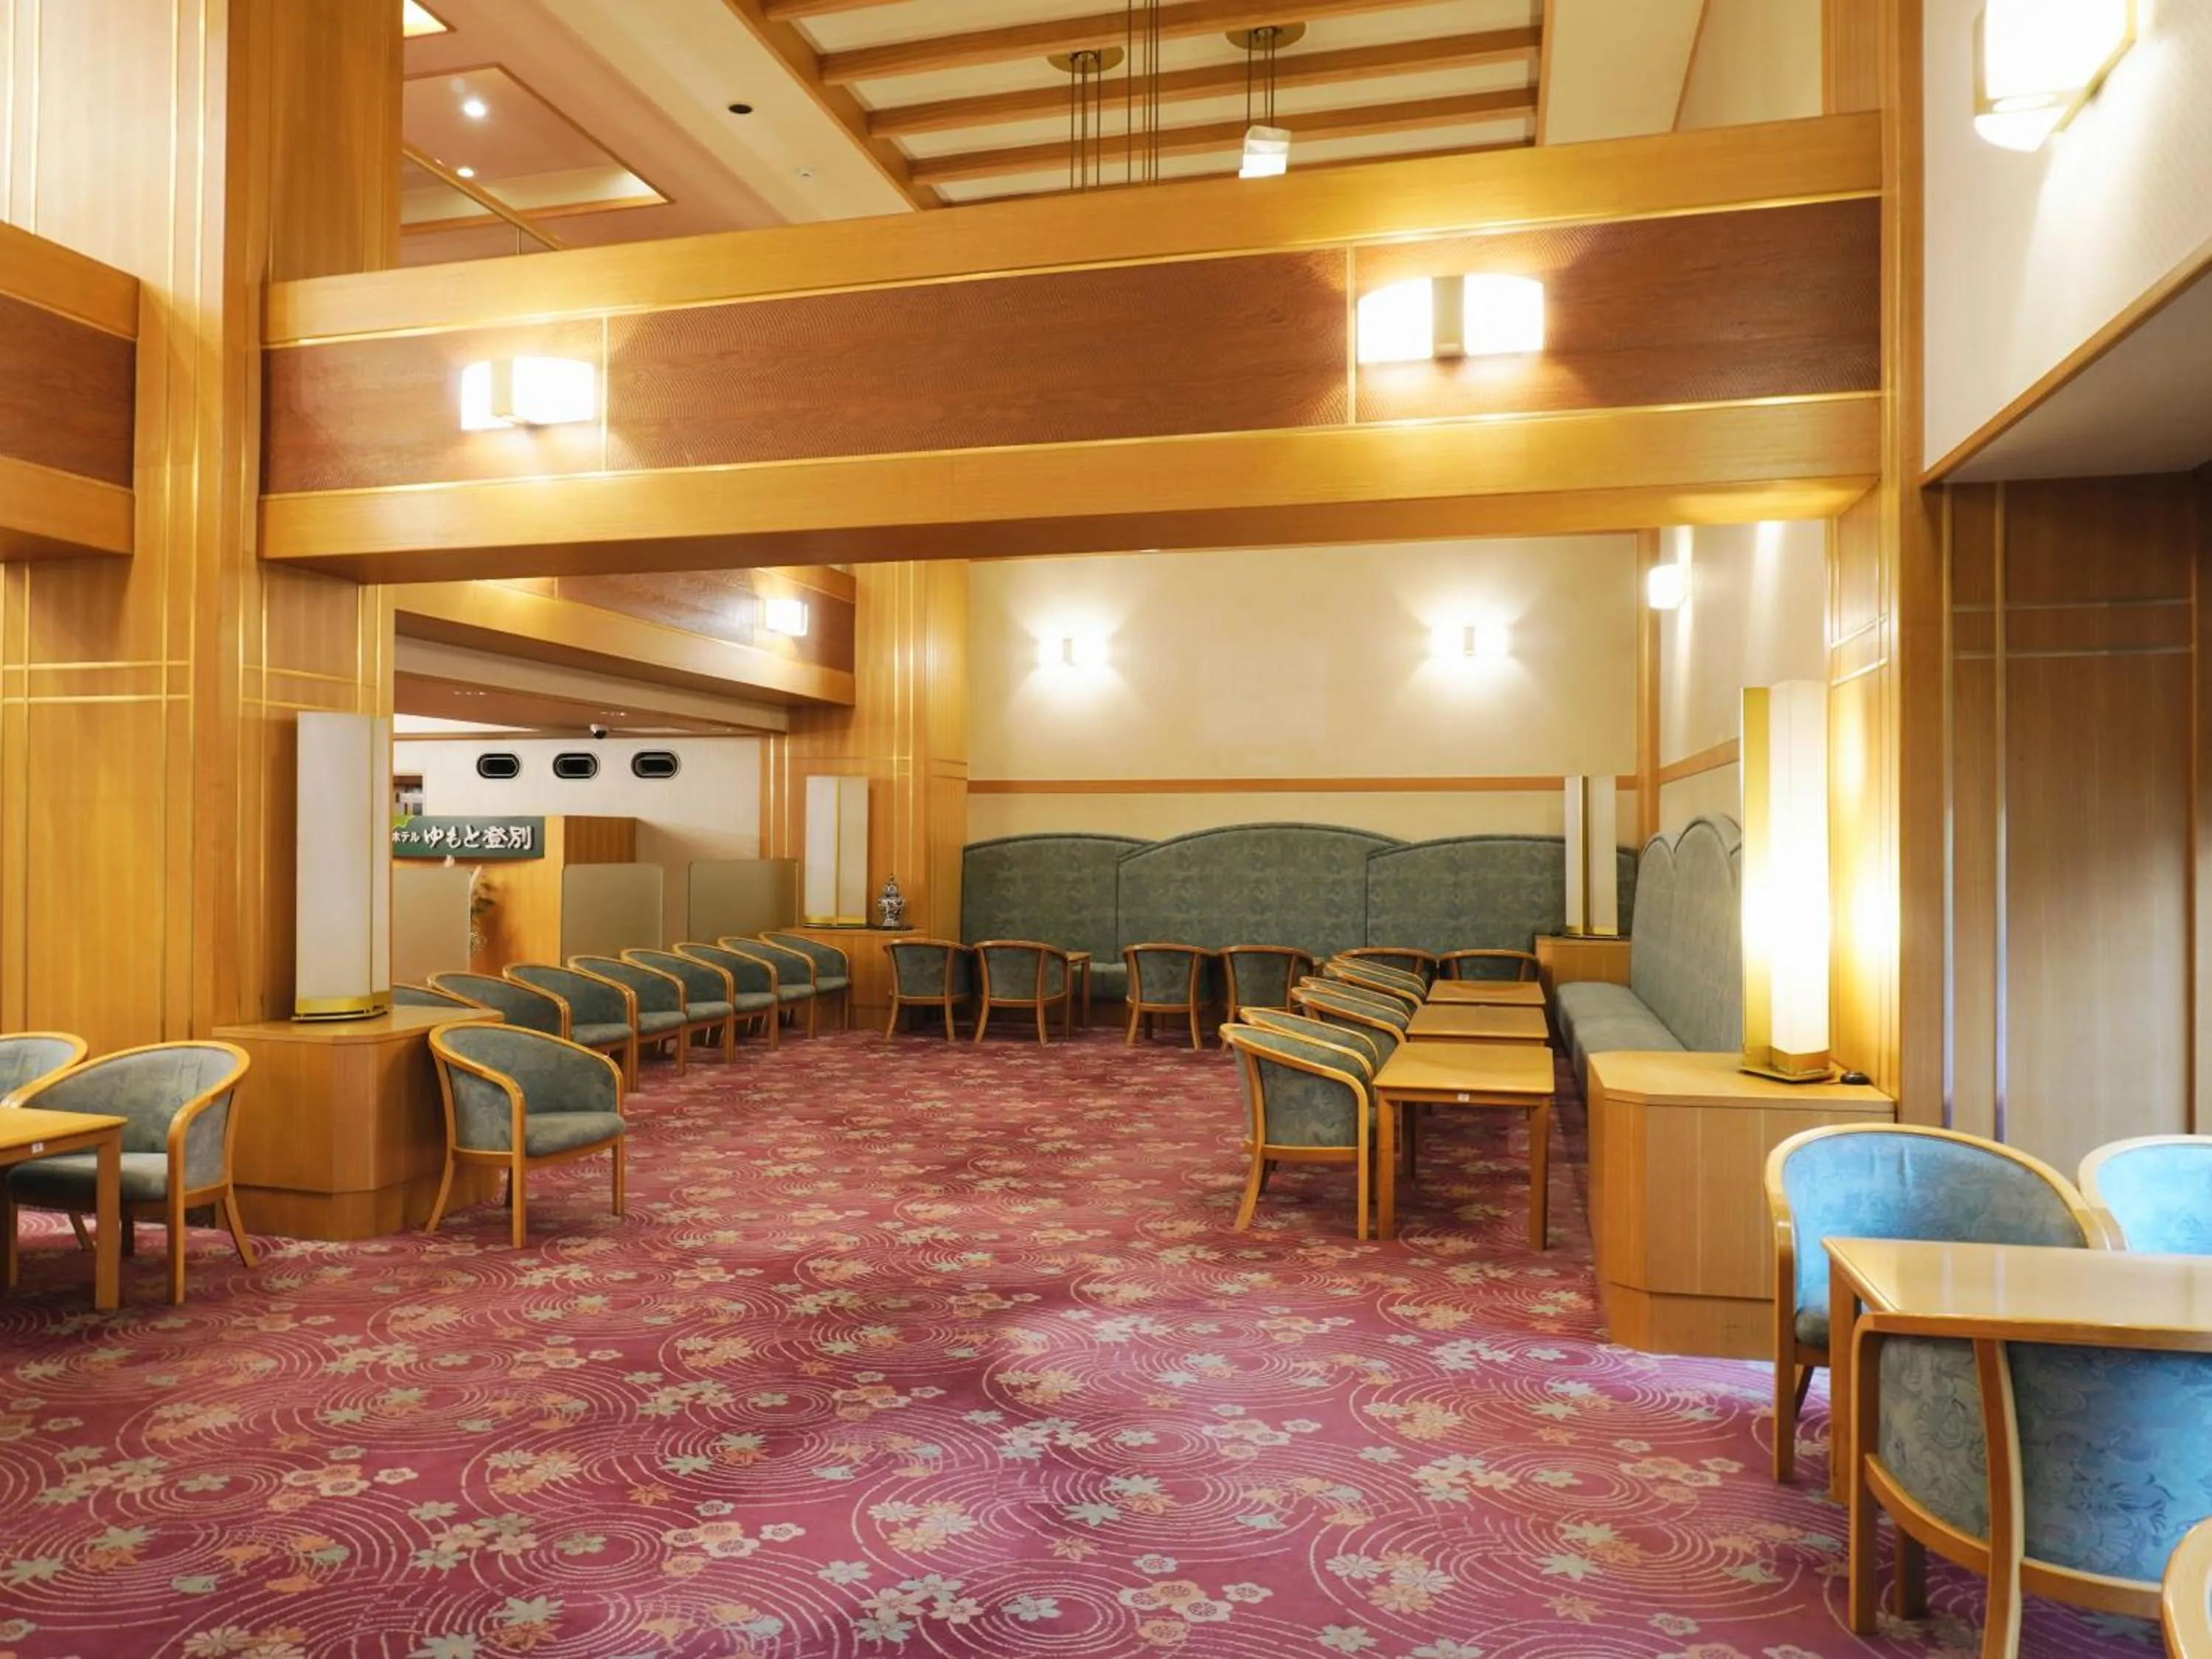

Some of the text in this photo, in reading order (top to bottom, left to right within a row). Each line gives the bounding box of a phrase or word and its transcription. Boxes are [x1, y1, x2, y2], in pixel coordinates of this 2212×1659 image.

[392, 824, 532, 849] ホテル ゆもと登別
